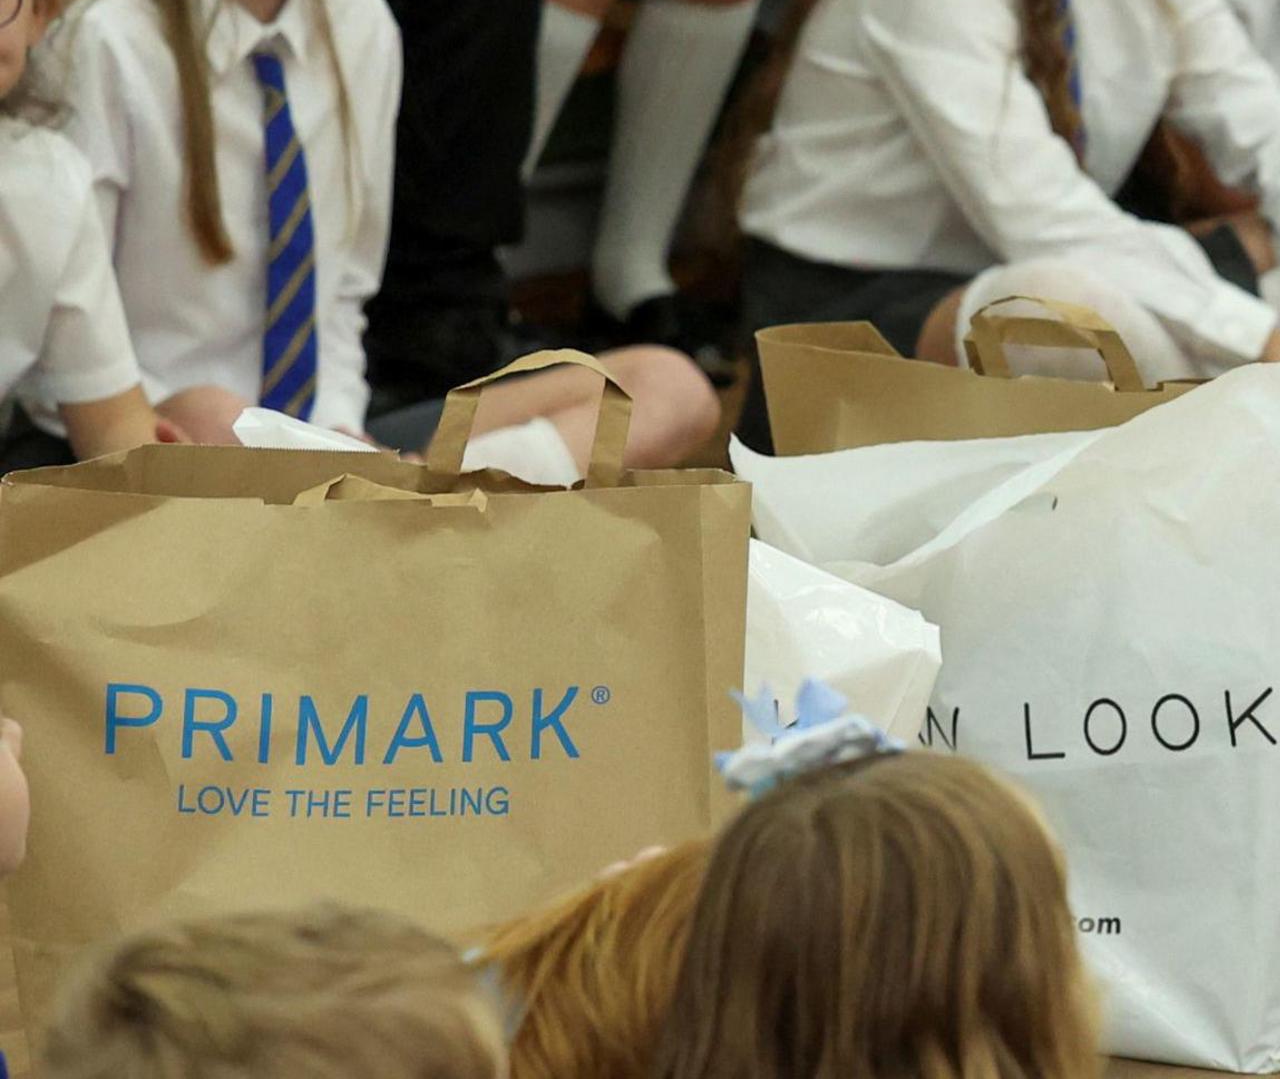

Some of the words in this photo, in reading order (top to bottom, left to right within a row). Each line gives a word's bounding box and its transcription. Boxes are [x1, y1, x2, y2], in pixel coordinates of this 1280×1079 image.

[1023, 687, 1278, 760] LOOK
[177, 785, 271, 817] LOVE
[285, 790, 352, 818] THE
[366, 786, 510, 817] FEELING
